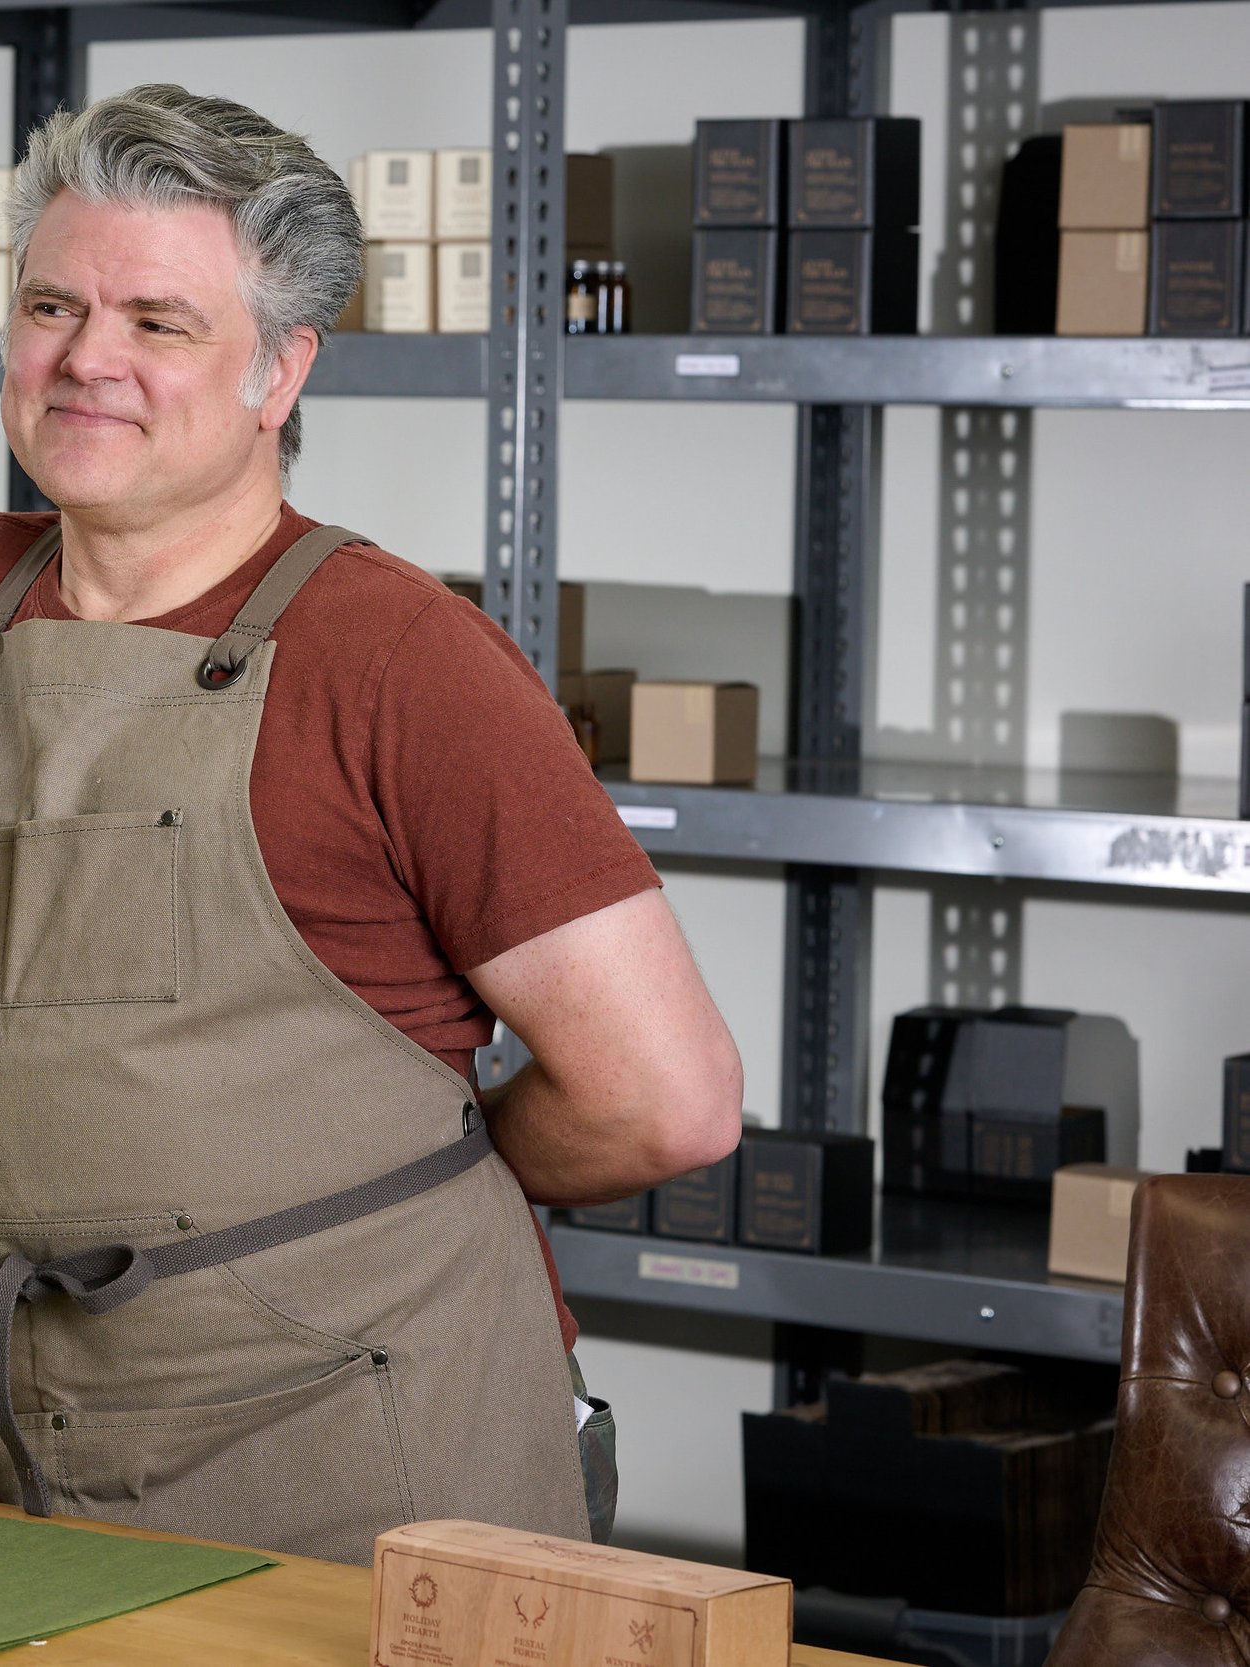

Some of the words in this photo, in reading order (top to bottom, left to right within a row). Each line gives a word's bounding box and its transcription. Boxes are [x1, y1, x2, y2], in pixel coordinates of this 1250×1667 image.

[402, 1612, 441, 1627] HOLIDAY
[405, 1624, 440, 1639] HEARTH
[514, 1636, 546, 1651] FESTAL
[513, 1646, 546, 1661] FOREST
